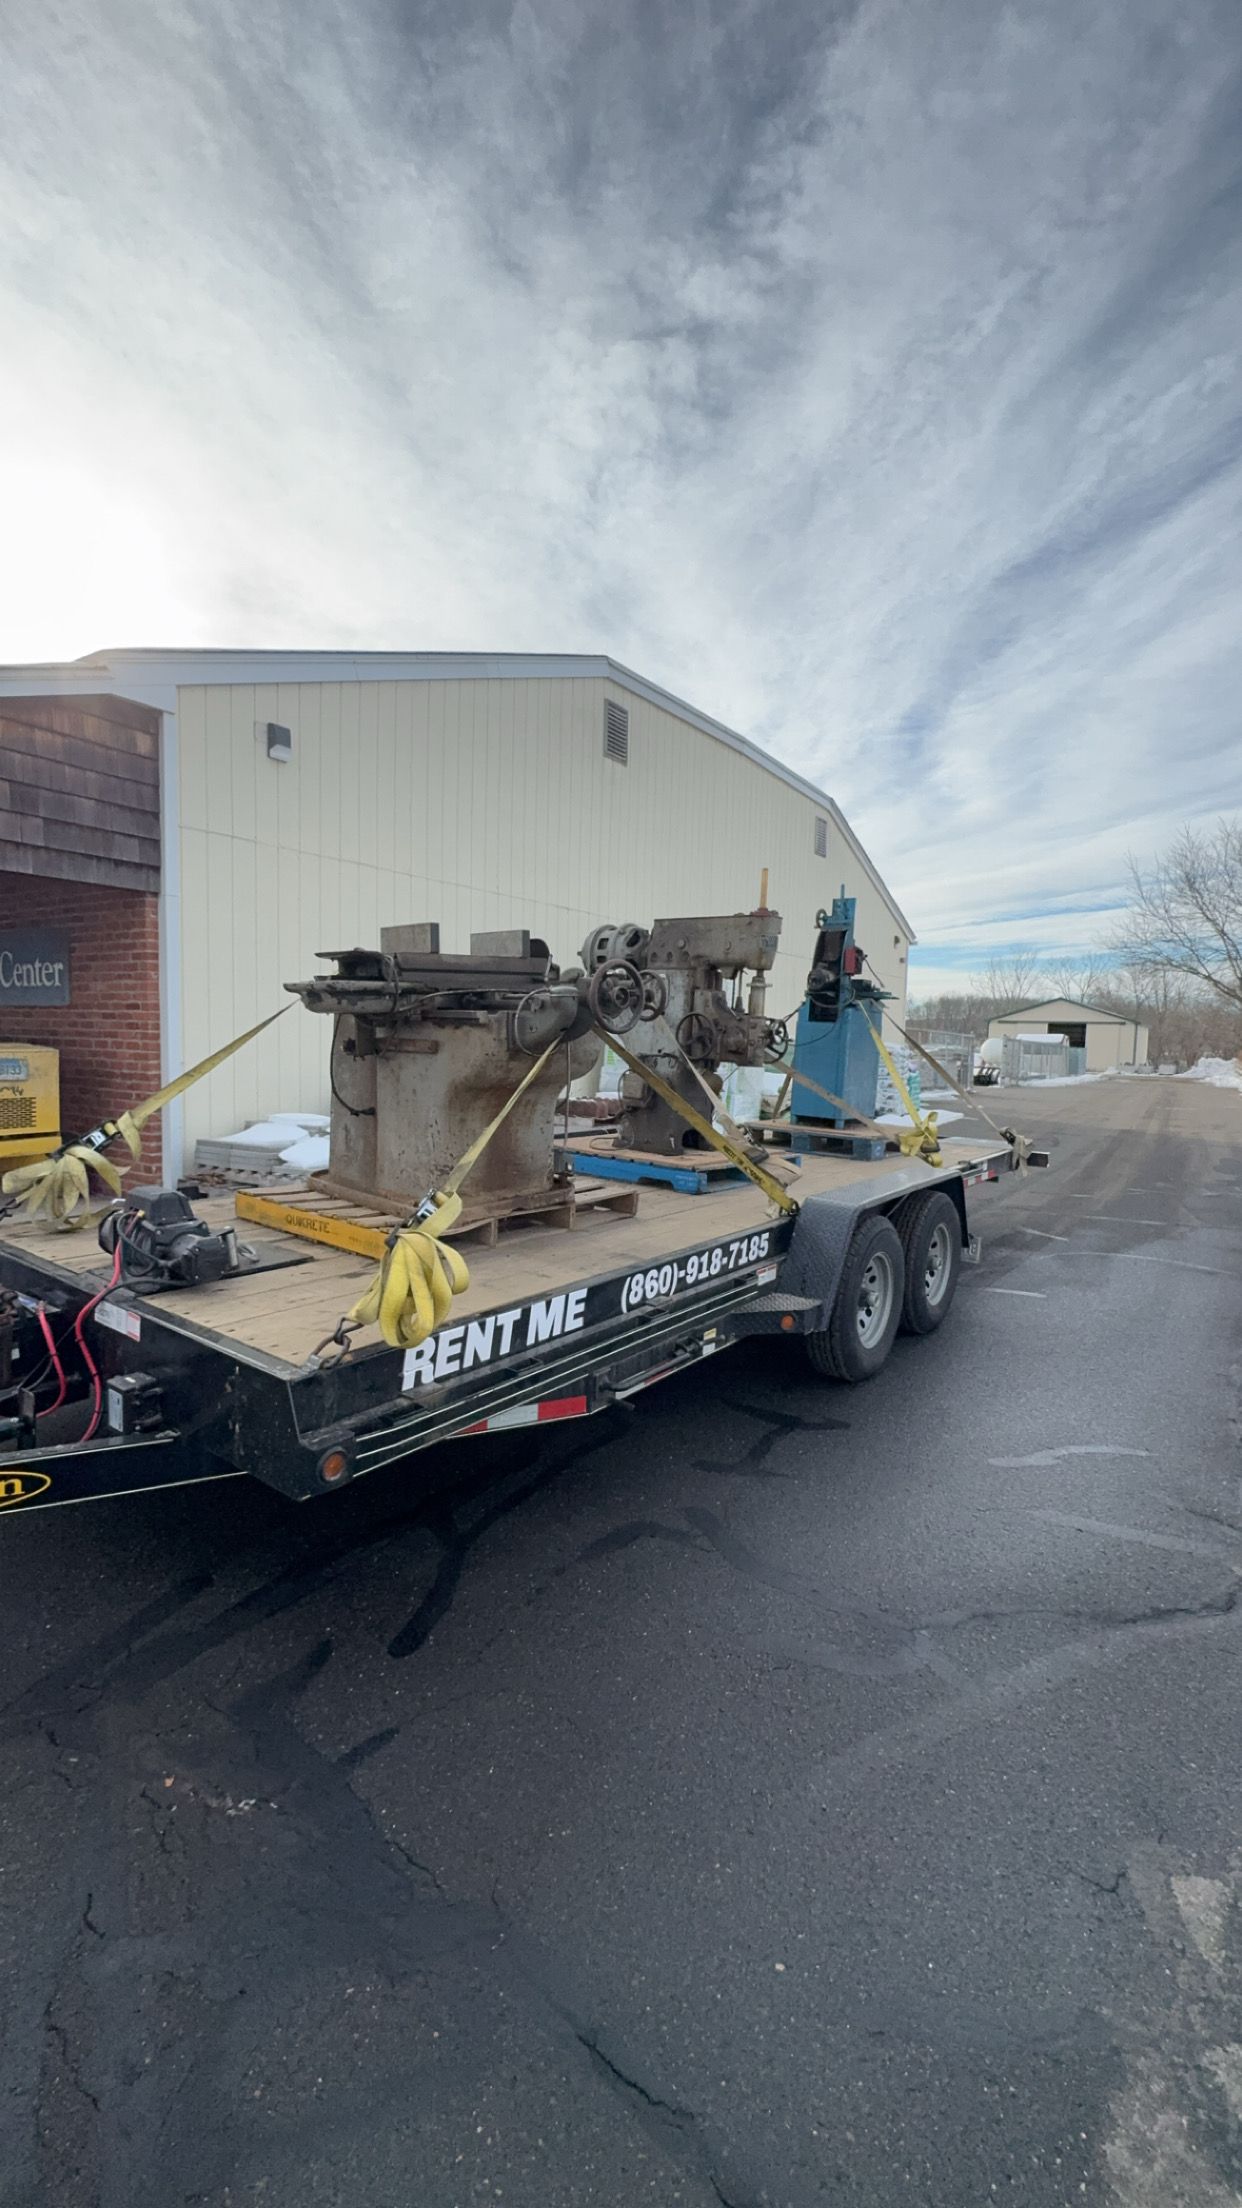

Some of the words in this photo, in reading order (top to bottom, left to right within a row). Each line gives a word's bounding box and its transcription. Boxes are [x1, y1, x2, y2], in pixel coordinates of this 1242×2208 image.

[0, 951, 64, 988] Center
[620, 1231, 770, 1314] (860)-918-7185
[401, 1308, 523, 1392] RENT
[526, 1287, 588, 1347] ME
